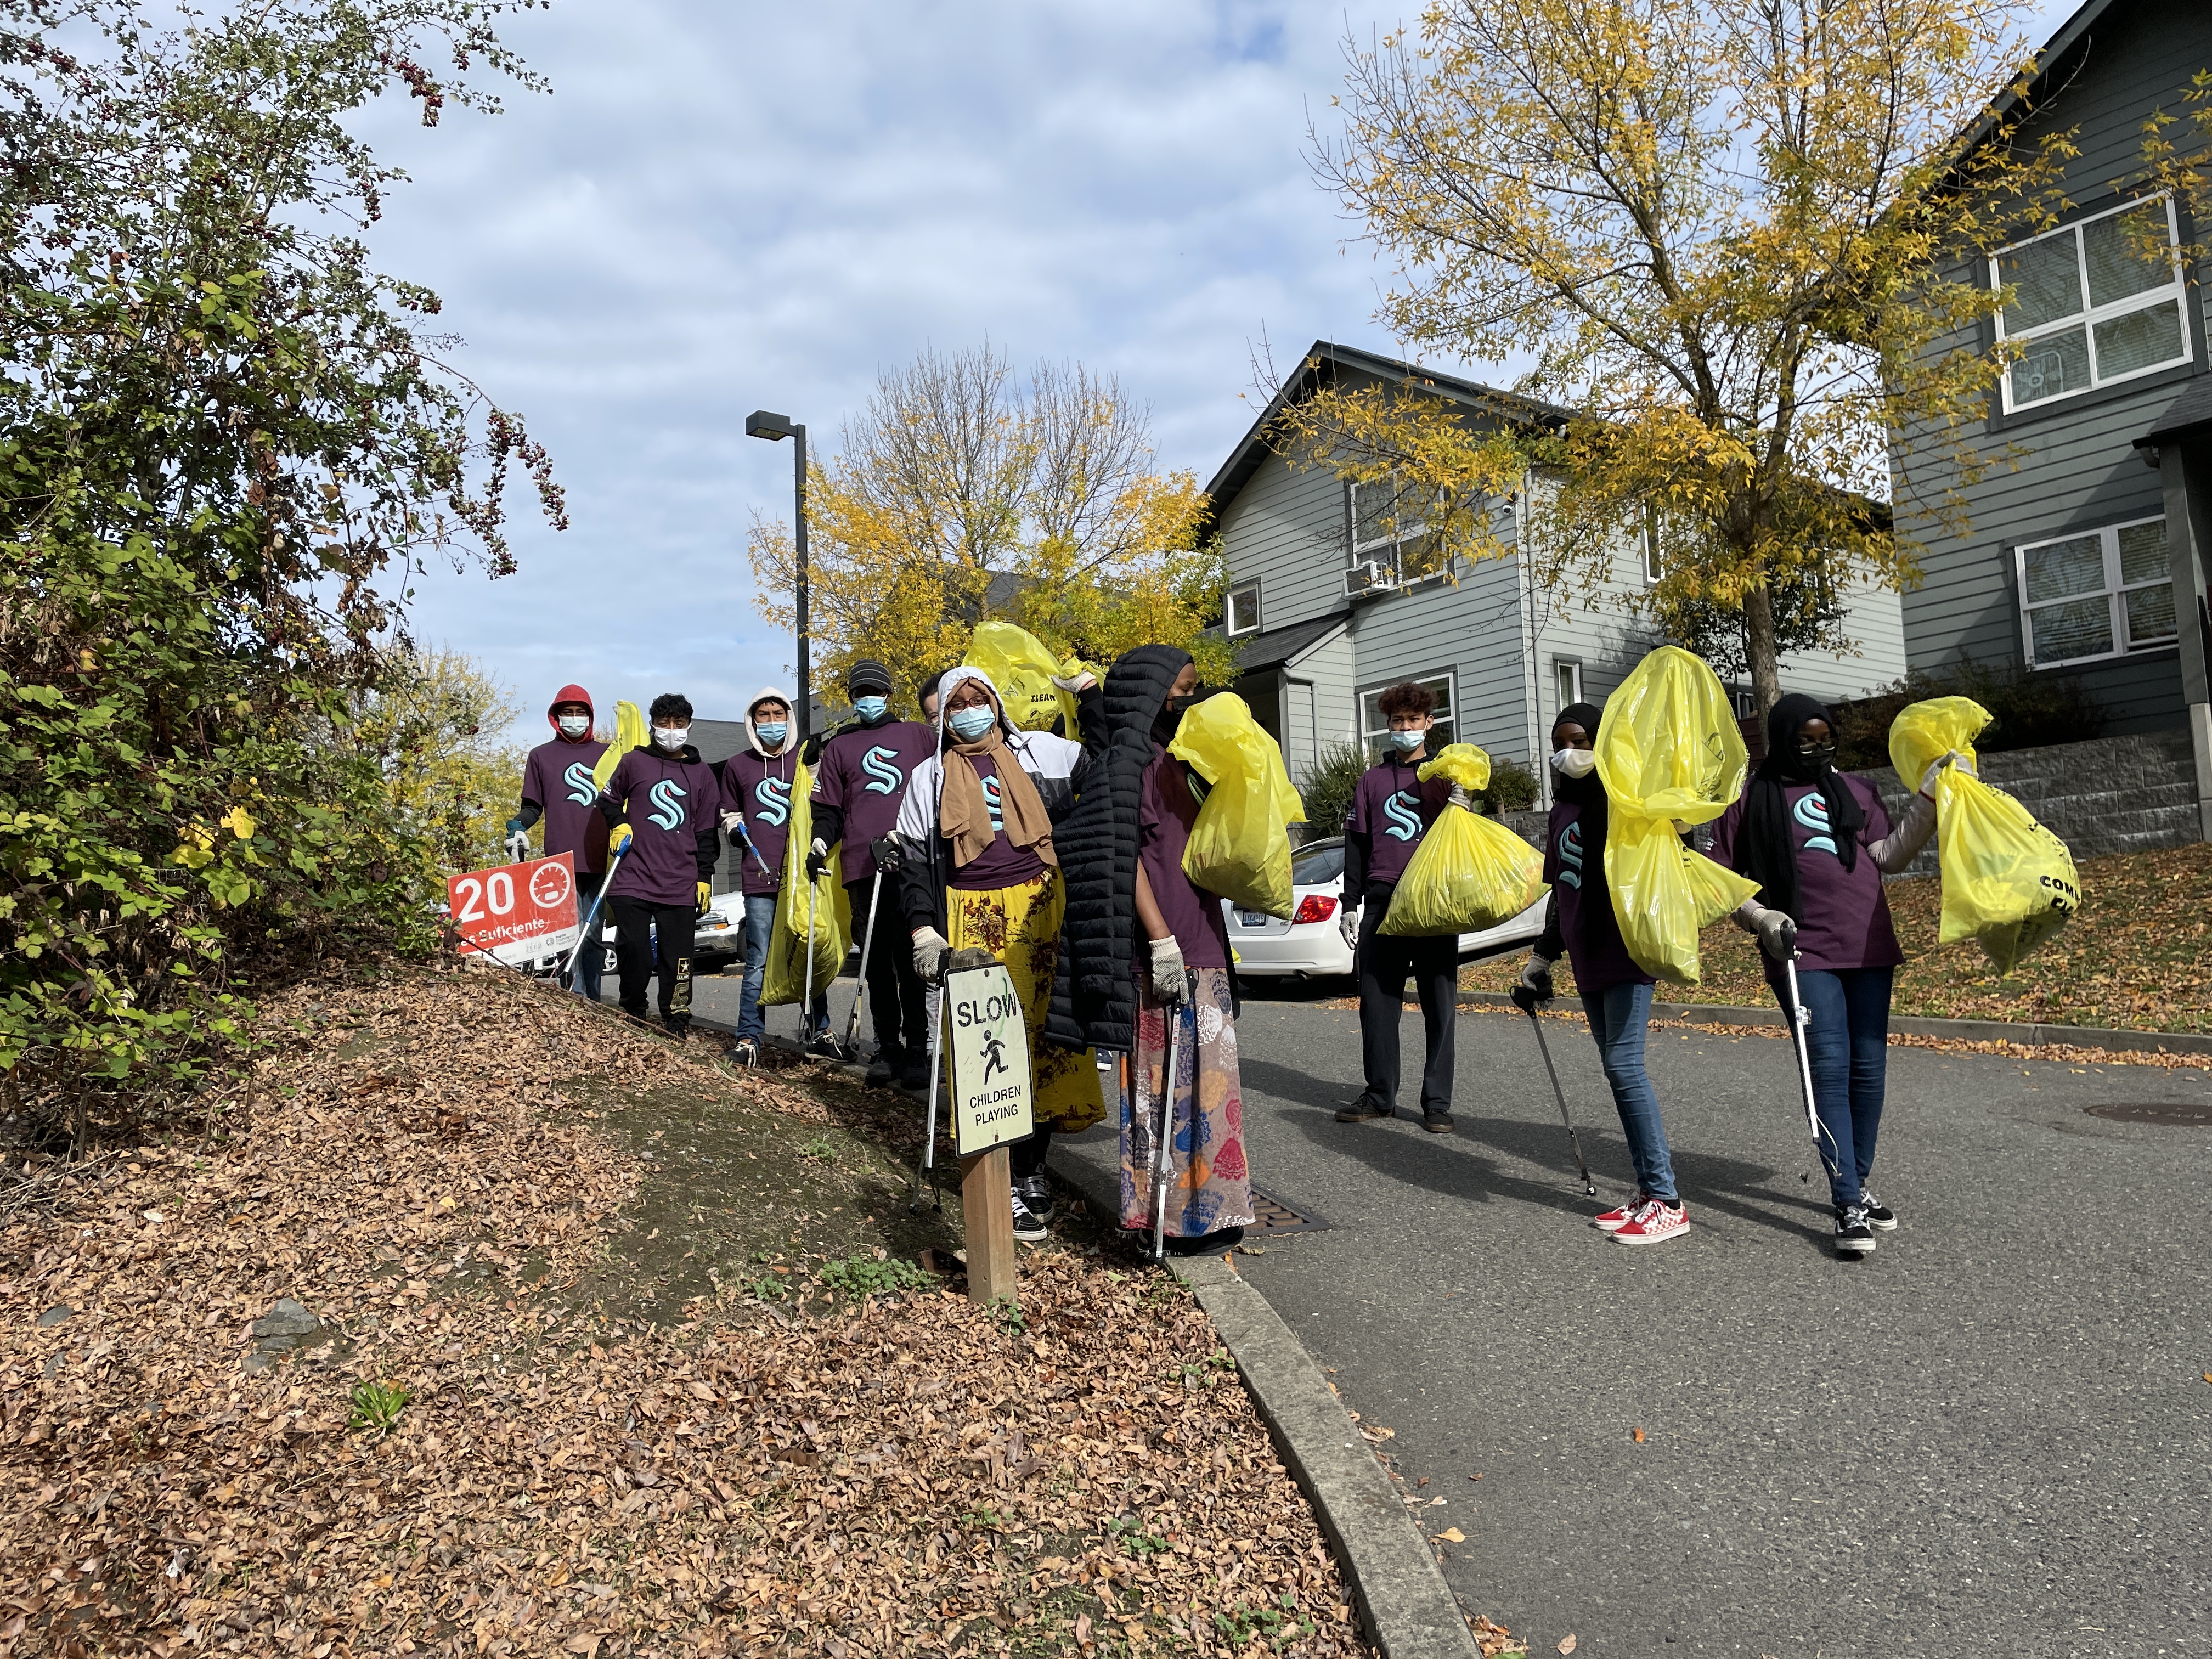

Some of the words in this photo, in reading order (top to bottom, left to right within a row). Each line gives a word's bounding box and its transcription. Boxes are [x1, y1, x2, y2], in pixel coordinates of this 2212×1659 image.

[1031, 693, 1056, 702] CLEAN
[455, 872, 515, 923] 20
[479, 919, 545, 943] Suficiente
[957, 992, 1017, 1028] SLOW
[970, 1085, 1021, 1109] CHILDREN
[975, 1103, 1018, 1126] PLAYING
